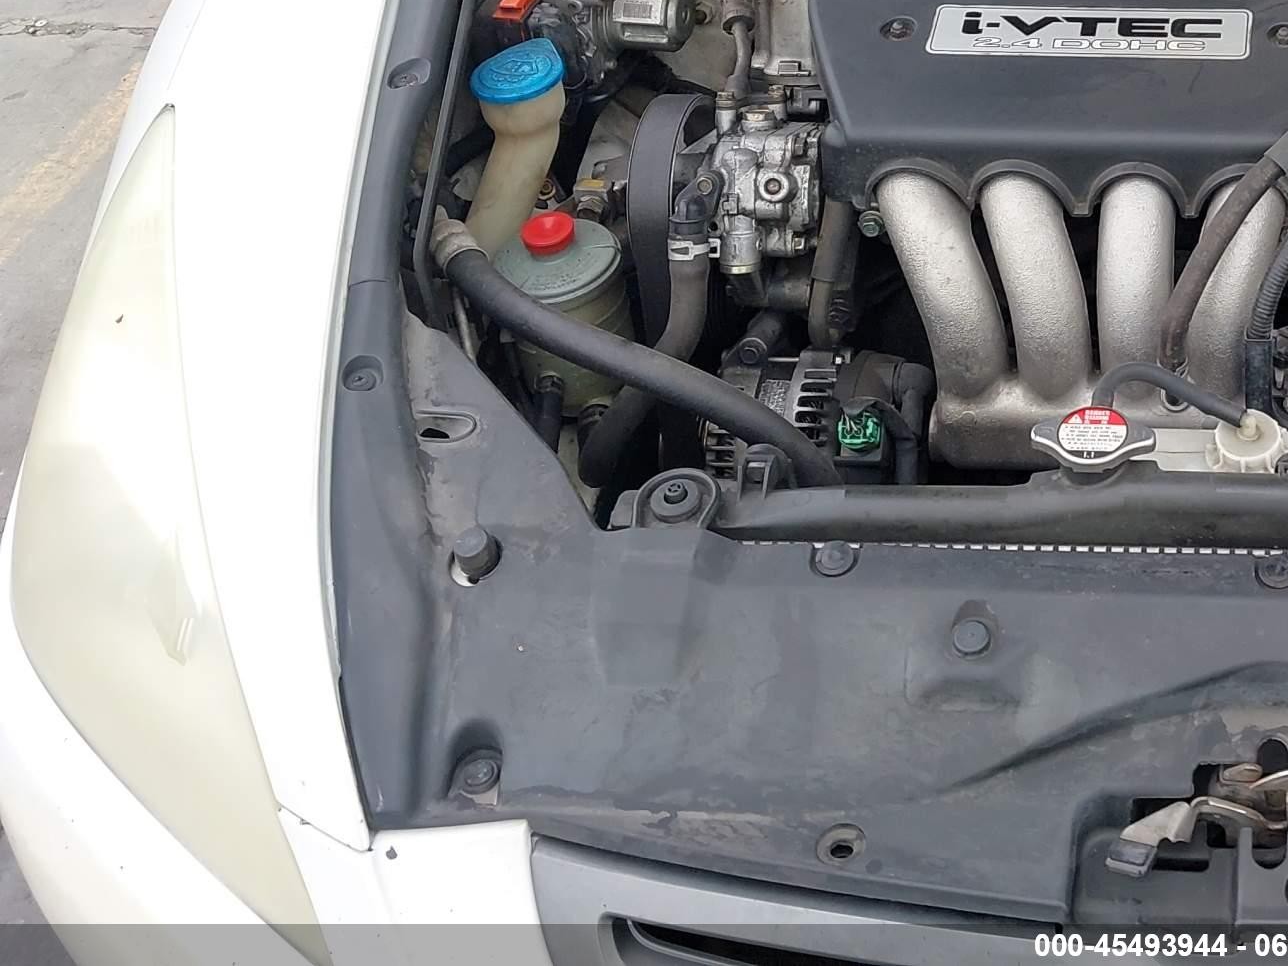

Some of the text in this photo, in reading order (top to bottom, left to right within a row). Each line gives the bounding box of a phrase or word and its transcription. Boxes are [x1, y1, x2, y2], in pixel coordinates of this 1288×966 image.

[961, 11, 1223, 39] i-VTEC
[972, 36, 1206, 51] 2.4 DOHC
